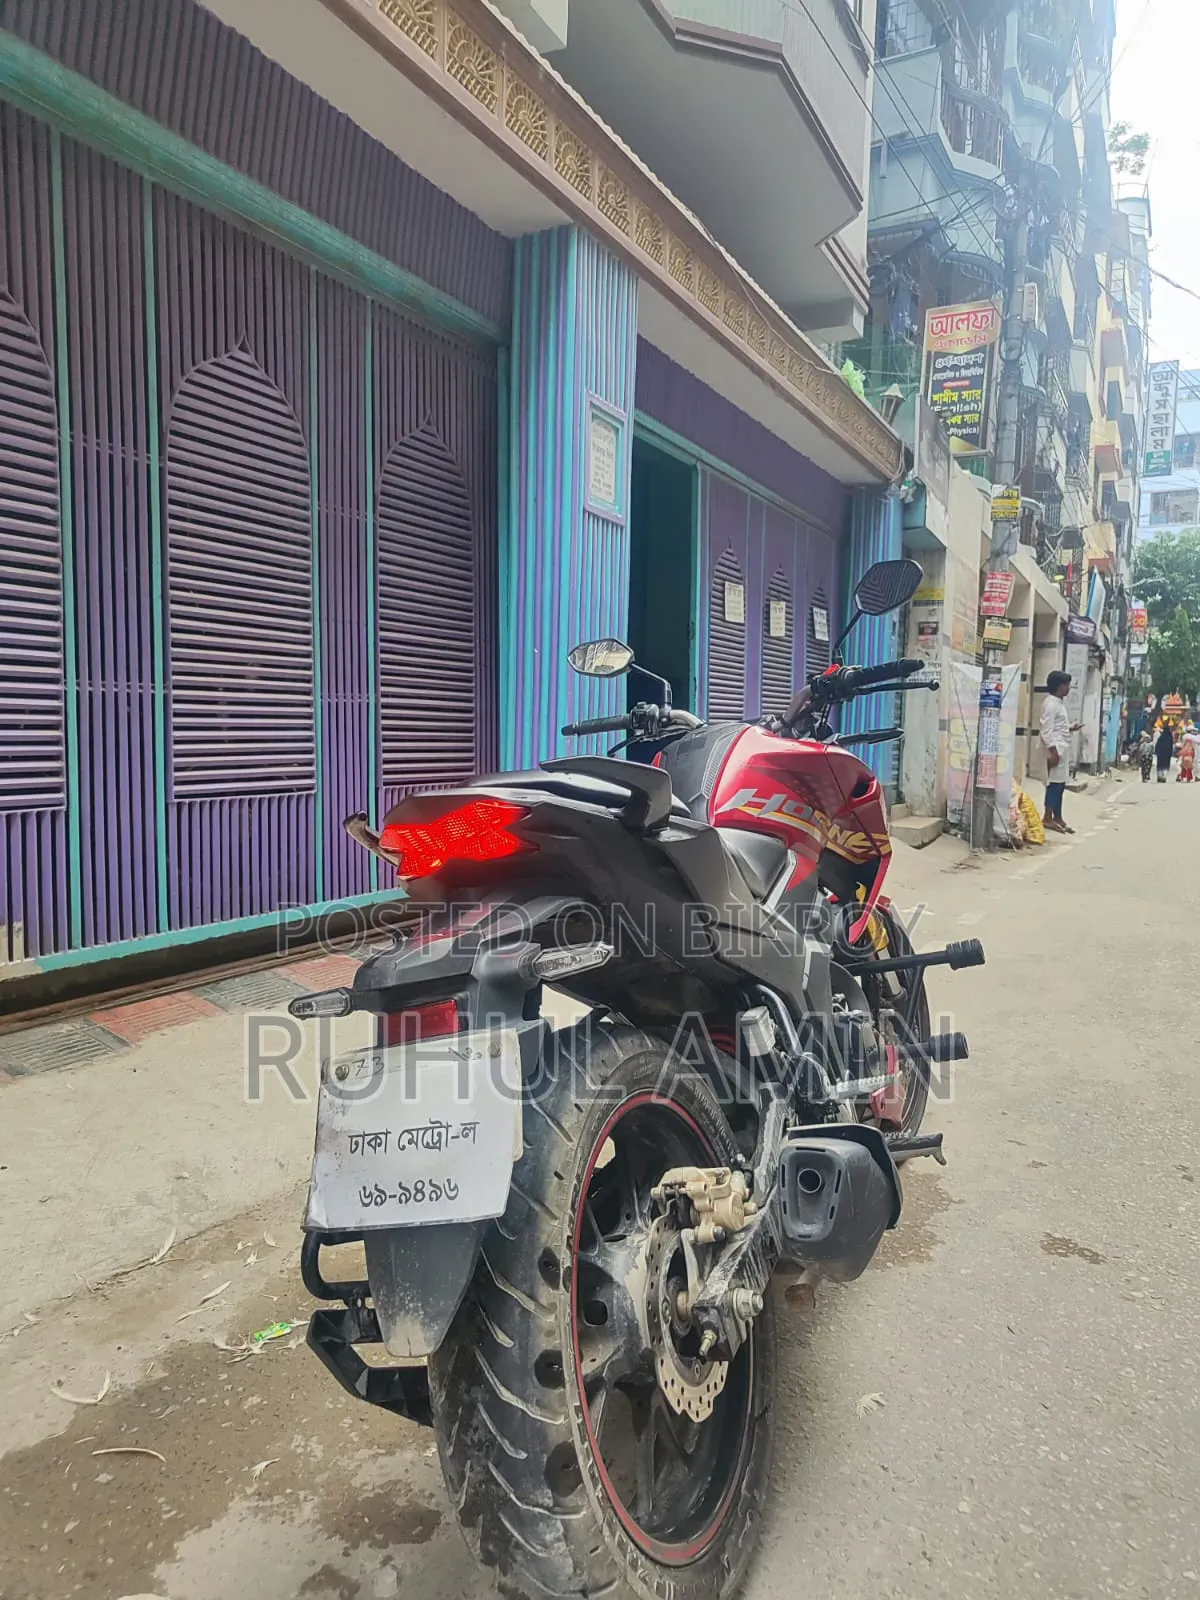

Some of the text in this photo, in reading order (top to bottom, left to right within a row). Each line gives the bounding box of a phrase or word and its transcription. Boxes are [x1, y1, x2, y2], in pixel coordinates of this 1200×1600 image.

[348, 1118, 480, 1156] ঢাকা মেট্রো-ল
[358, 1178, 460, 1208] ৬৯-৯৪৯৬
